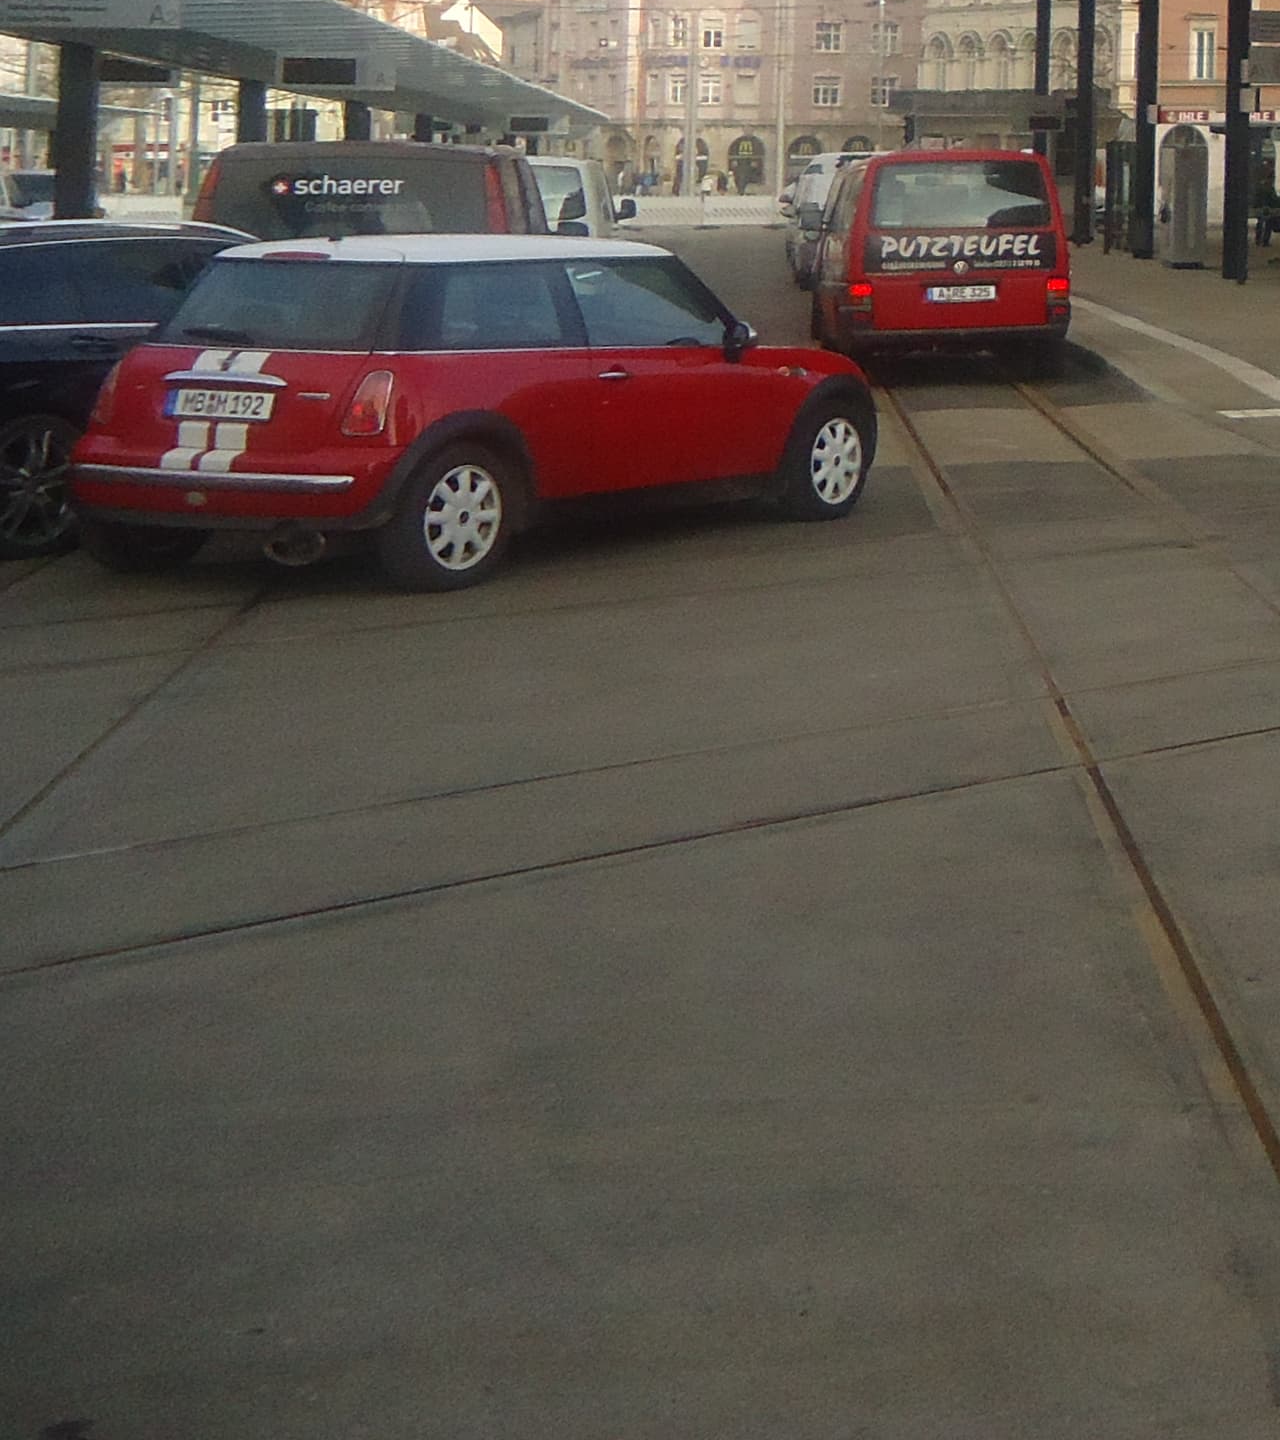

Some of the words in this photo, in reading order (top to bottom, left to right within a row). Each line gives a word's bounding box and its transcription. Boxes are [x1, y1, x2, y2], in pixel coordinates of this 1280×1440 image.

[1179, 111, 1205, 121] IHLE
[294, 174, 405, 195] schaerer
[881, 233, 1041, 258] PUTZTEUFEL
[970, 287, 991, 298] 325
[230, 395, 264, 416] 192
